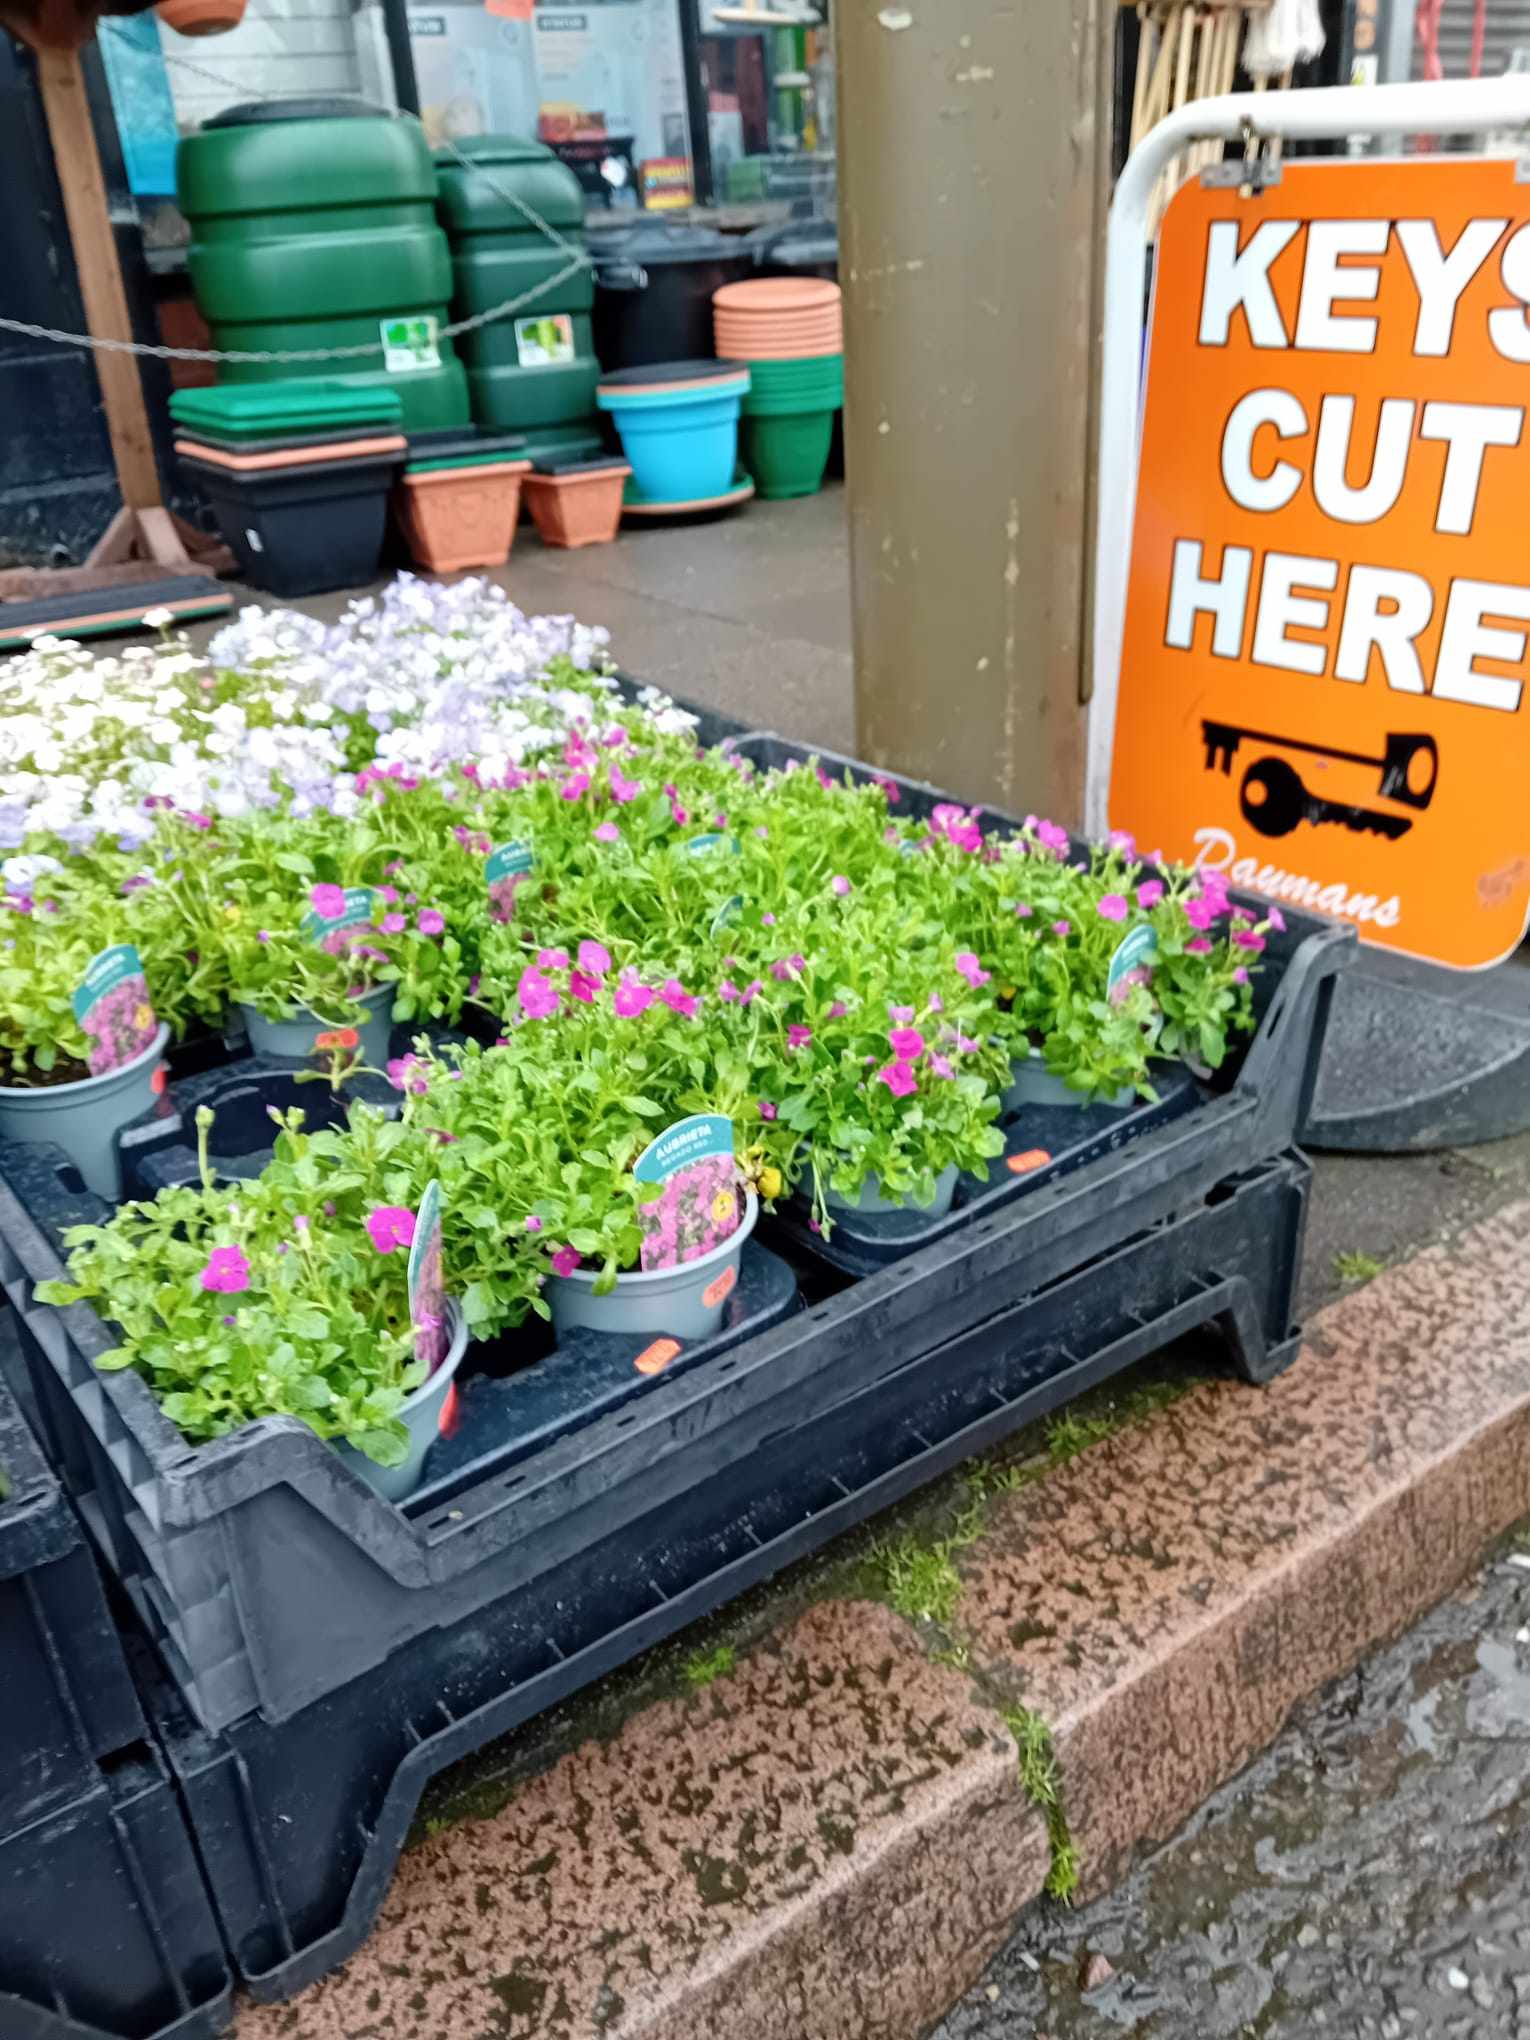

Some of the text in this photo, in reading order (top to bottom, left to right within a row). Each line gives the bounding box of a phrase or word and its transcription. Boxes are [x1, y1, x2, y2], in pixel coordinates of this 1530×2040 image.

[1219, 386, 1526, 536] CUT
[1163, 537, 1530, 712] HERE
[655, 1123, 713, 1161] AUBRIETA
